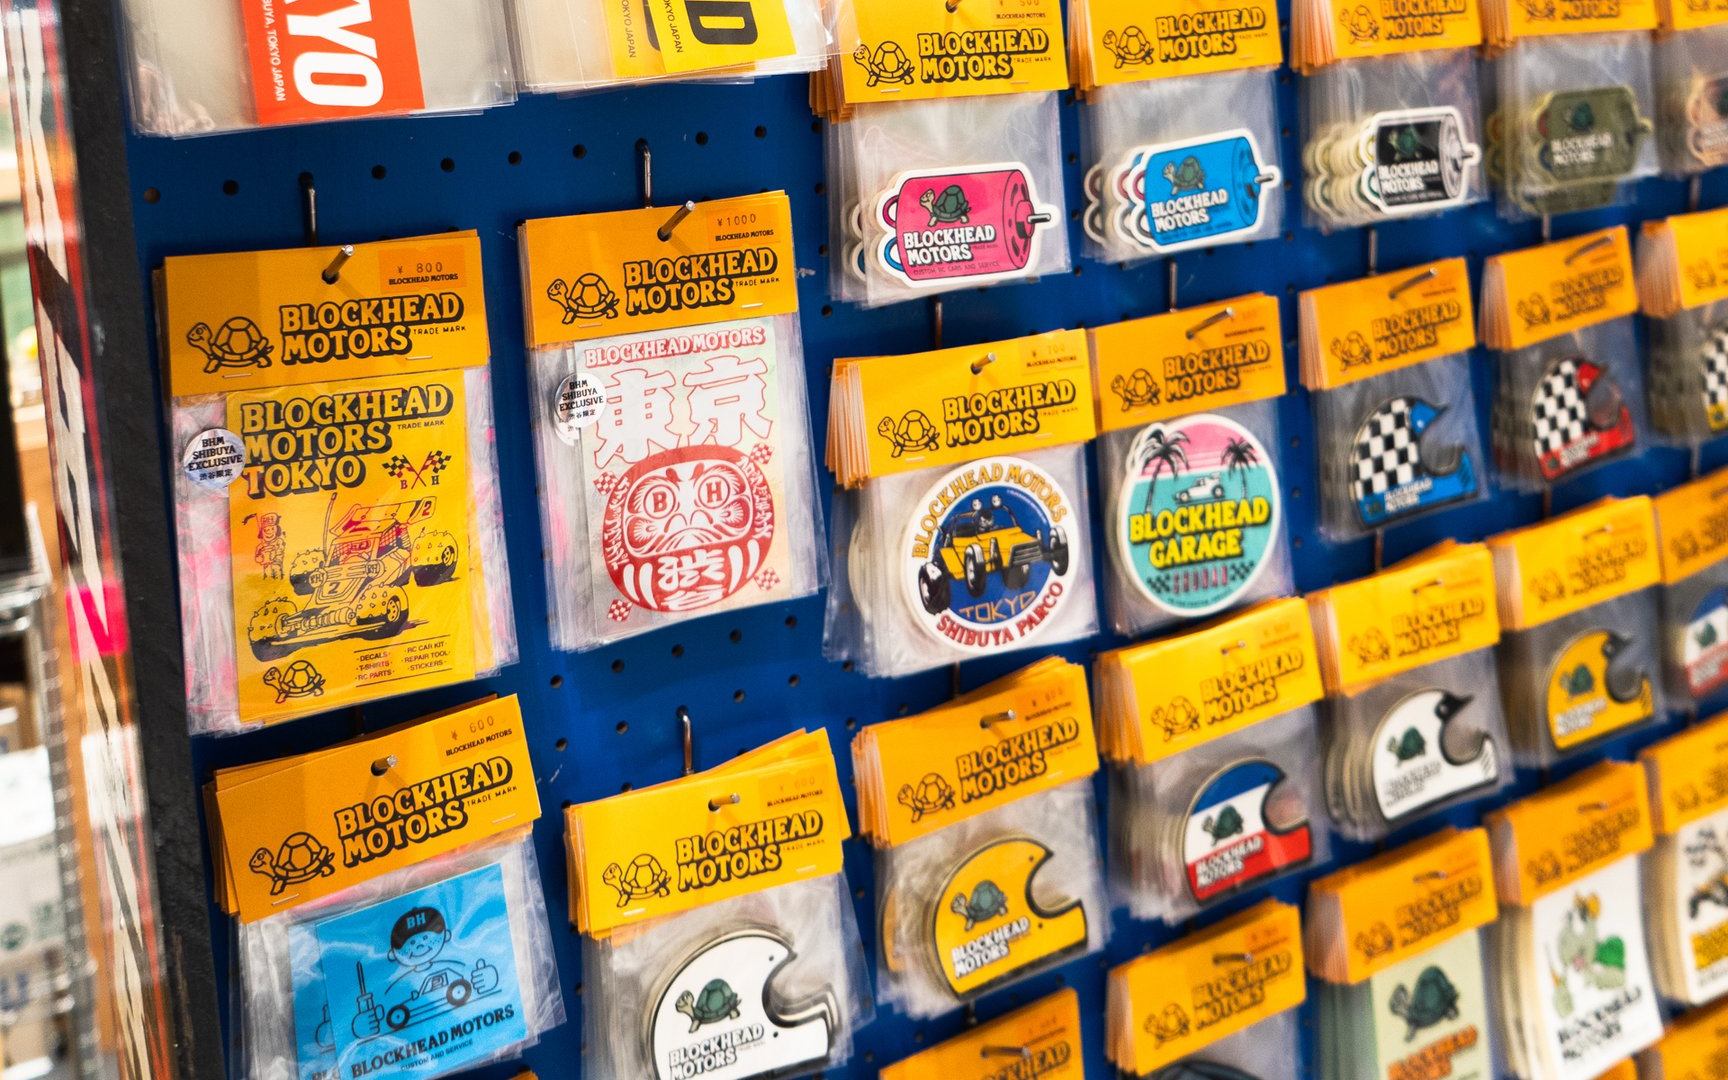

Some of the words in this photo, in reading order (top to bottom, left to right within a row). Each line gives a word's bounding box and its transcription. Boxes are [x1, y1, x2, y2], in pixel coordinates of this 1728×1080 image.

[670, 23, 684, 53] JAPAN
[1155, 7, 1266, 38] BLOCKHEAD
[1384, 15, 1444, 40] MOTORS
[267, 29, 281, 66] TOKYO
[917, 28, 1049, 59] BLOCKHEAD
[1159, 32, 1237, 62] MOTORS
[272, 67, 286, 101] JAPAN
[919, 53, 1013, 84] MOTORS
[1378, 159, 1440, 180] BLOCKHEAD
[1151, 189, 1229, 216] BLOCKHEAD
[1155, 208, 1210, 234] MOTORS
[715, 231, 750, 242] BLOCKHEAD
[751, 229, 774, 238] MOTORS
[903, 224, 997, 250] BLOCKHEAD
[415, 261, 444, 274] 800
[623, 247, 778, 288] BLOCKHEAD
[906, 243, 974, 267] MOTORS
[388, 275, 430, 286] BLOCKHEAD
[431, 273, 459, 281] MOTORS
[626, 277, 736, 316] MOTORS
[736, 279, 758, 288] TRADE
[279, 291, 464, 335] BLOCKHEAD
[281, 325, 412, 366] MOTORS
[413, 327, 439, 335] TRADE
[443, 325, 466, 333] MARK
[584, 334, 699, 369] BLOCKHEAD
[692, 325, 768, 351] MOTORS
[1163, 339, 1271, 379] BLOCKHEAD
[559, 395, 604, 411] EXCLUSIVE
[562, 387, 598, 401] SHIBUYA
[569, 379, 588, 390] BHM
[942, 379, 1077, 422] BLOCKHEAD
[1165, 367, 1240, 402] MOTORS
[240, 384, 454, 434] BLOCKHEAD
[594, 354, 774, 470] 東京
[202, 436, 225, 447] BHM
[243, 421, 393, 462] MOTORS
[397, 423, 422, 431] TRADE
[423, 419, 445, 427] MARK
[945, 409, 1040, 448] MOTORS
[188, 454, 243, 471] EXCLUSIVE
[192, 445, 236, 460] SHIBUYA
[244, 455, 367, 499] TOKYO
[652, 490, 667, 513] B
[706, 480, 723, 504] H
[911, 463, 1004, 558] BLOCKHEAD
[1006, 463, 1068, 523] MOTORS
[1129, 496, 1271, 544] BLOCKHEAD
[1149, 528, 1243, 570] GARAGE
[327, 581, 341, 594] 2
[958, 590, 1037, 621] TOKYO
[936, 614, 1014, 648] SHIBUYA
[1016, 581, 1063, 637] PARCO
[1200, 648, 1304, 703] BLOCKHEAD
[1204, 679, 1279, 725] MOTORS
[445, 738, 486, 757] BLOCKHEAD
[485, 728, 513, 745] MOTORS
[468, 715, 495, 733] 600
[956, 717, 1079, 777] BLOCKHEAD
[960, 750, 1047, 804] MOTORS
[334, 756, 513, 839] BLOCKHEAD
[342, 799, 468, 869] MOTORS
[466, 793, 492, 808] TRADE
[495, 785, 518, 799] MARK
[675, 810, 823, 865] BLOCKHEAD
[677, 843, 782, 893] MOTORS
[1195, 836, 1264, 873] BLOCKHEAD
[406, 912, 426, 930] BH
[951, 916, 1031, 963] BLOCKHEAD
[954, 940, 1010, 980] MOTORS
[351, 1031, 449, 1079] BLOCKHEAD
[451, 1004, 515, 1038] MOTORS
[669, 1023, 765, 1067] BLOCKHEAD
[671, 1047, 737, 1080] MOTORS
